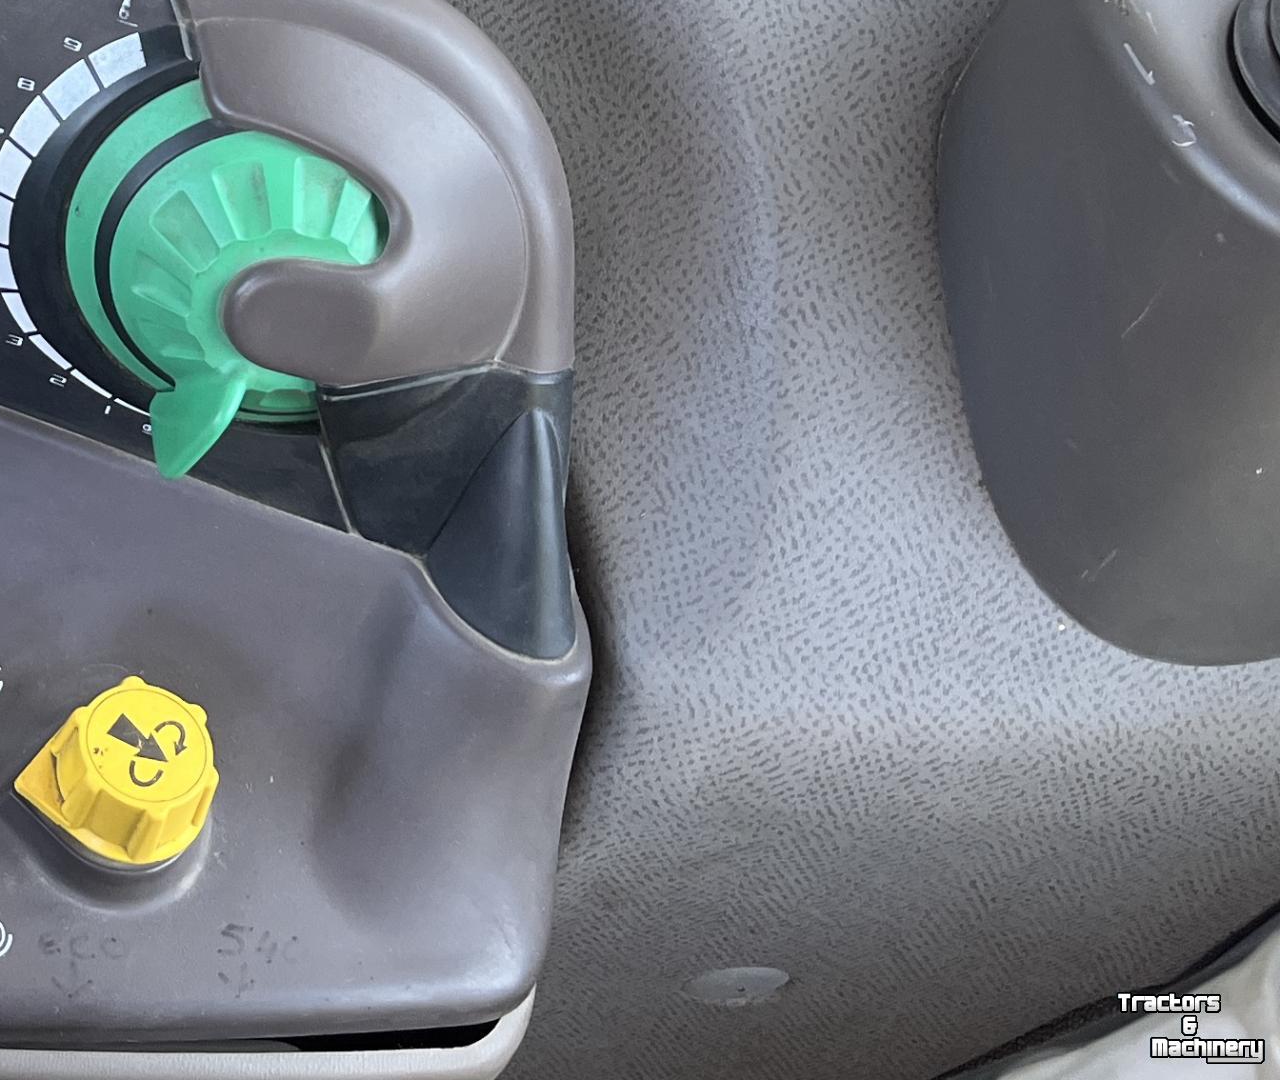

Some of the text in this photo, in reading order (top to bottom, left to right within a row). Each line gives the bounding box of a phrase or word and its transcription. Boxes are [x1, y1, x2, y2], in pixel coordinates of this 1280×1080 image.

[63, 36, 82, 52] 9
[17, 77, 36, 91] 8
[5, 334, 24, 346] 3
[49, 373, 67, 387] 2
